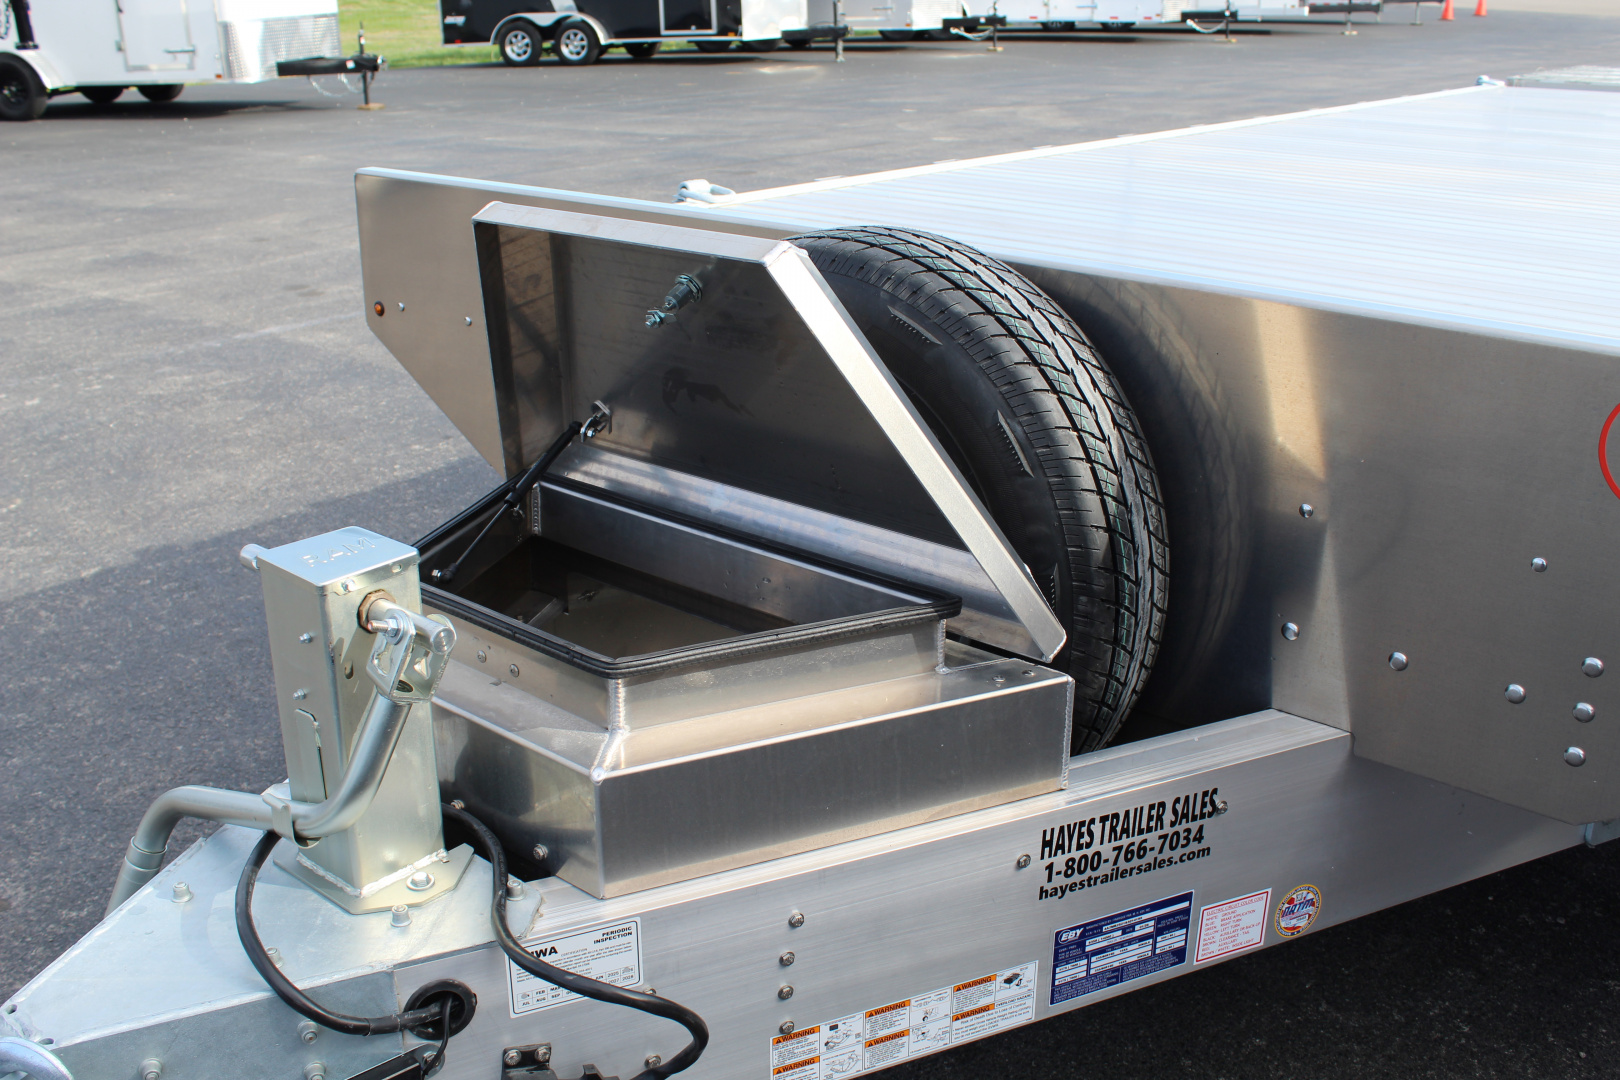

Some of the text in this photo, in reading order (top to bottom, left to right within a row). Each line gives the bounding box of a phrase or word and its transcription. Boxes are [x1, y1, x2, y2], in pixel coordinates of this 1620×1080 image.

[302, 537, 375, 567] RAM
[1040, 788, 1218, 860] HAYES TRAILER SALES
[1045, 824, 1204, 883] 1-800-766-7034
[1039, 847, 1210, 900] hayestrailersales.com
[1207, 907, 1224, 916] ELECTRIC
[1224, 903, 1240, 911] CIRCUIT
[1233, 909, 1256, 918] APPLICATION
[593, 931, 632, 944] INSPECTION
[602, 926, 632, 937] PERIODIC
[1061, 927, 1084, 941] EBY
[1219, 934, 1239, 942] CLEARANCE
[532, 946, 558, 958] WA
[962, 976, 992, 990] WARNING
[874, 1001, 906, 1015] WARNING
[960, 1006, 990, 1019] WARNING
[782, 1028, 815, 1042] WARNING
[873, 1031, 905, 1045] WARNING
[782, 1058, 815, 1073] WARNING
